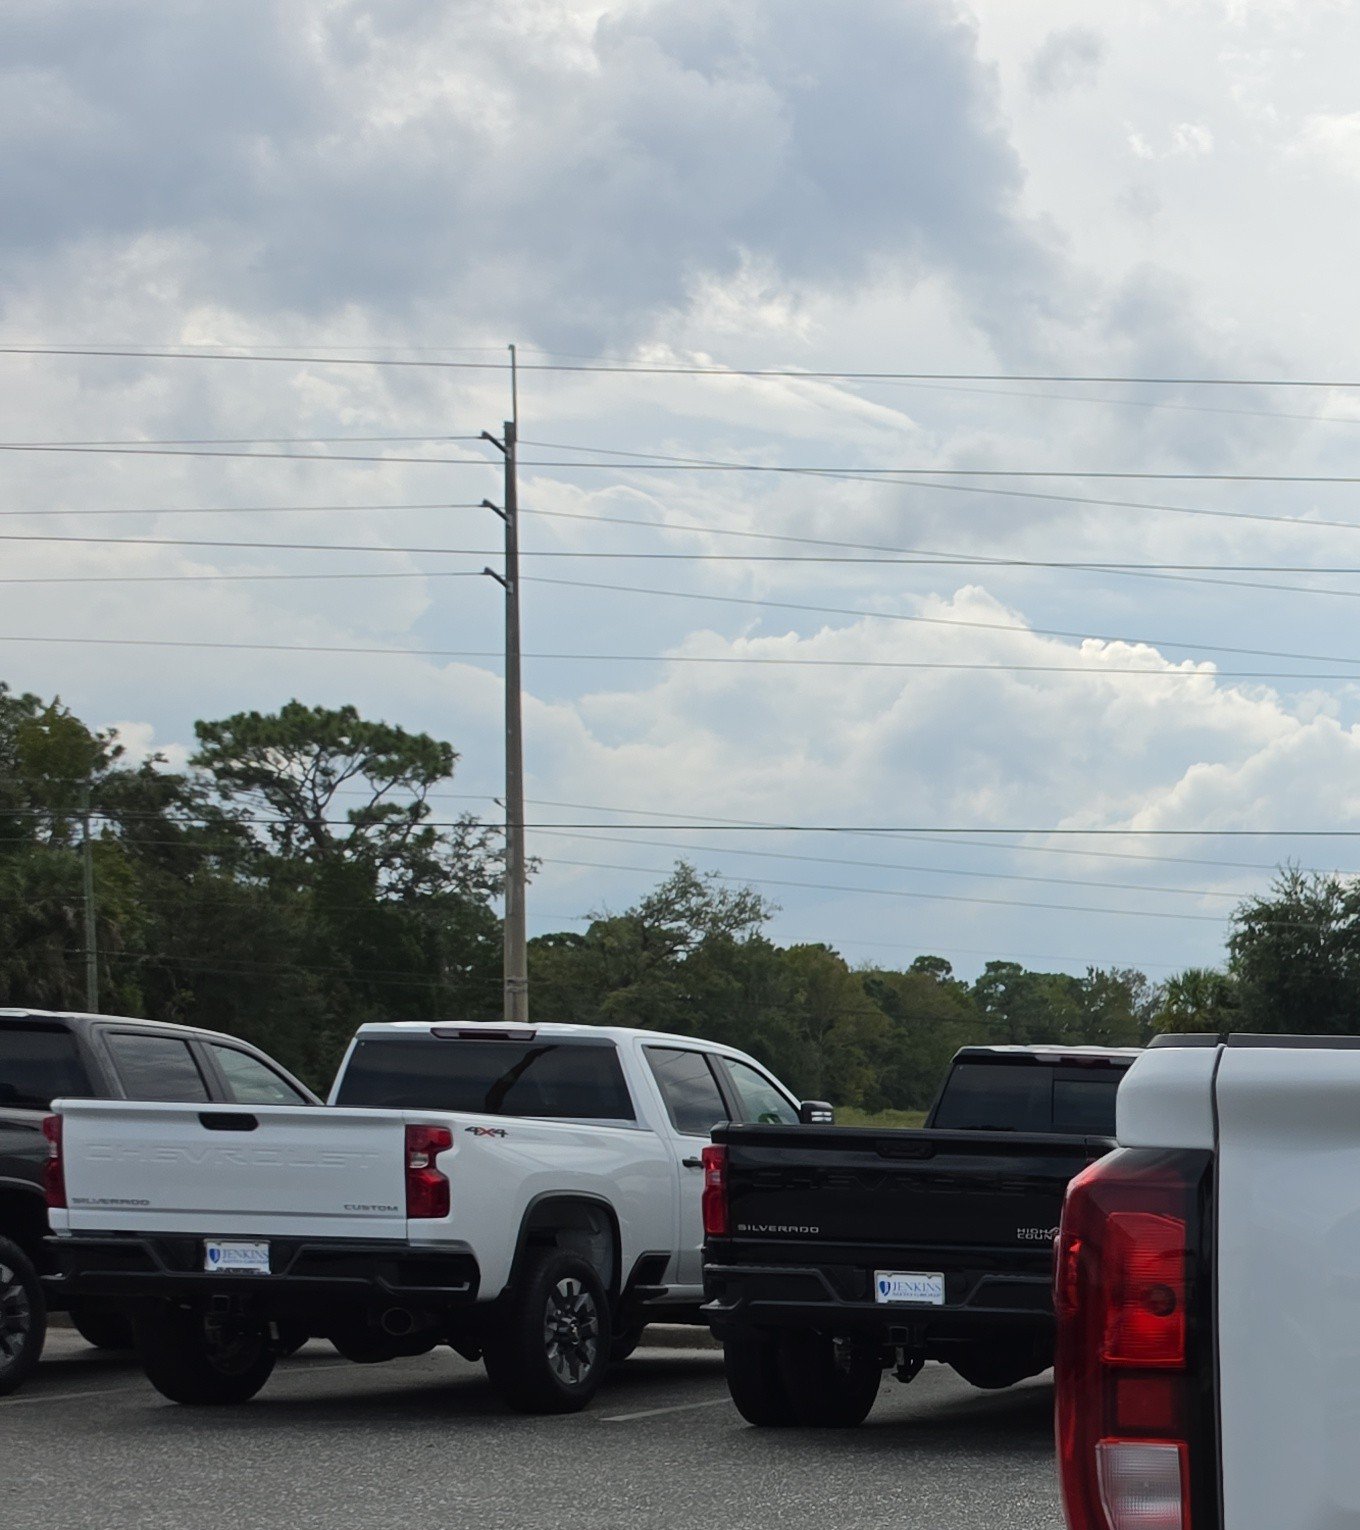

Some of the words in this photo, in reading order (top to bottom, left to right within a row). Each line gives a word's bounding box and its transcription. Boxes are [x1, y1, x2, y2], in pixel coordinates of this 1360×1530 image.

[343, 1204, 399, 1212] CUSTOM
[737, 1223, 820, 1234] SILVERADO
[892, 1281, 942, 1292] JENKINS
